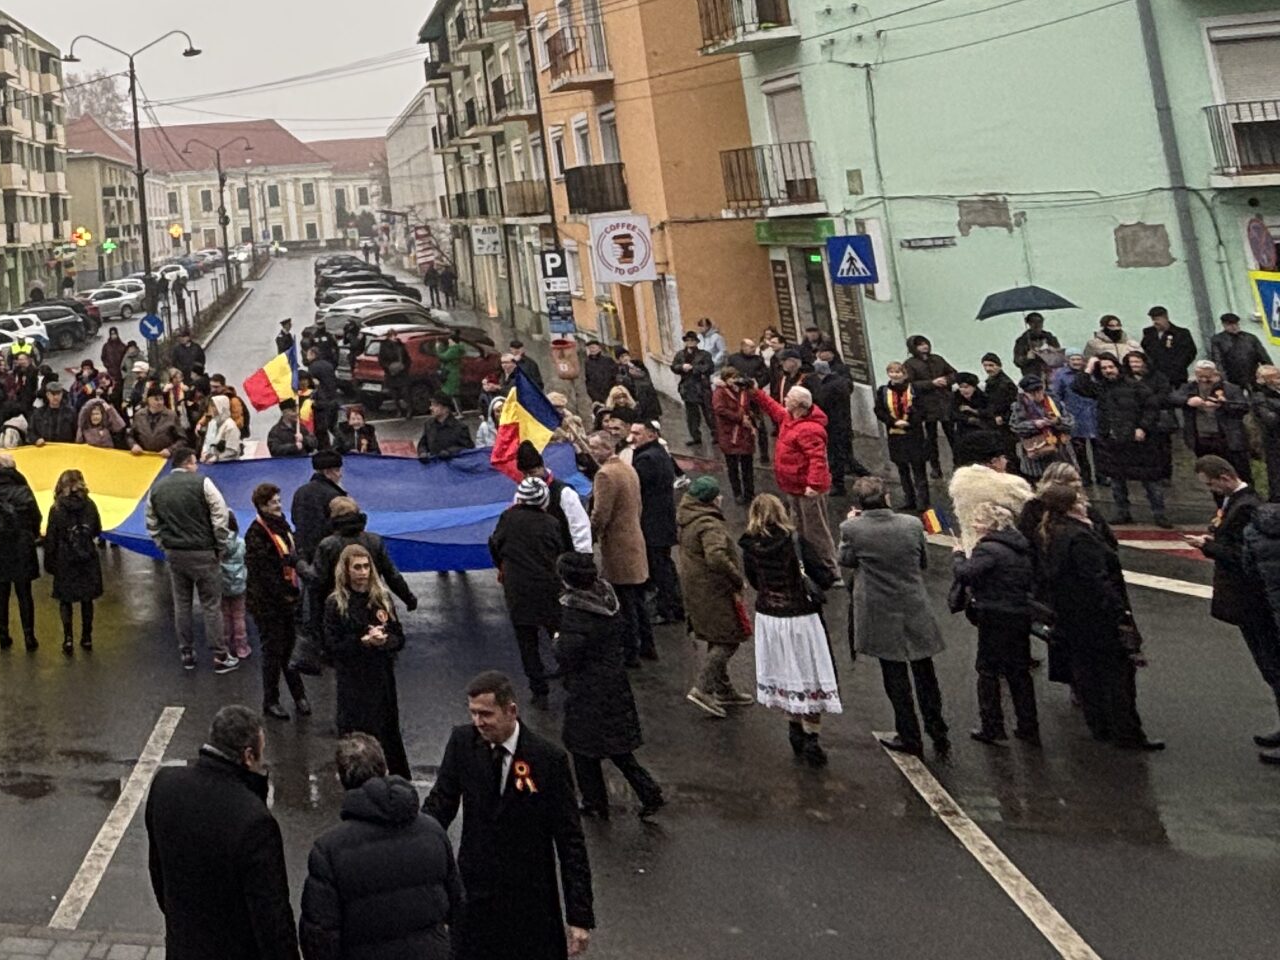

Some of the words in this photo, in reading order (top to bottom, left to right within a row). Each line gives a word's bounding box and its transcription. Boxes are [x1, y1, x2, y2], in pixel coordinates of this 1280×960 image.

[604, 223, 638, 234] COFFEE
[545, 253, 561, 276] P
[615, 267, 625, 275] TO
[627, 265, 640, 275] GO
